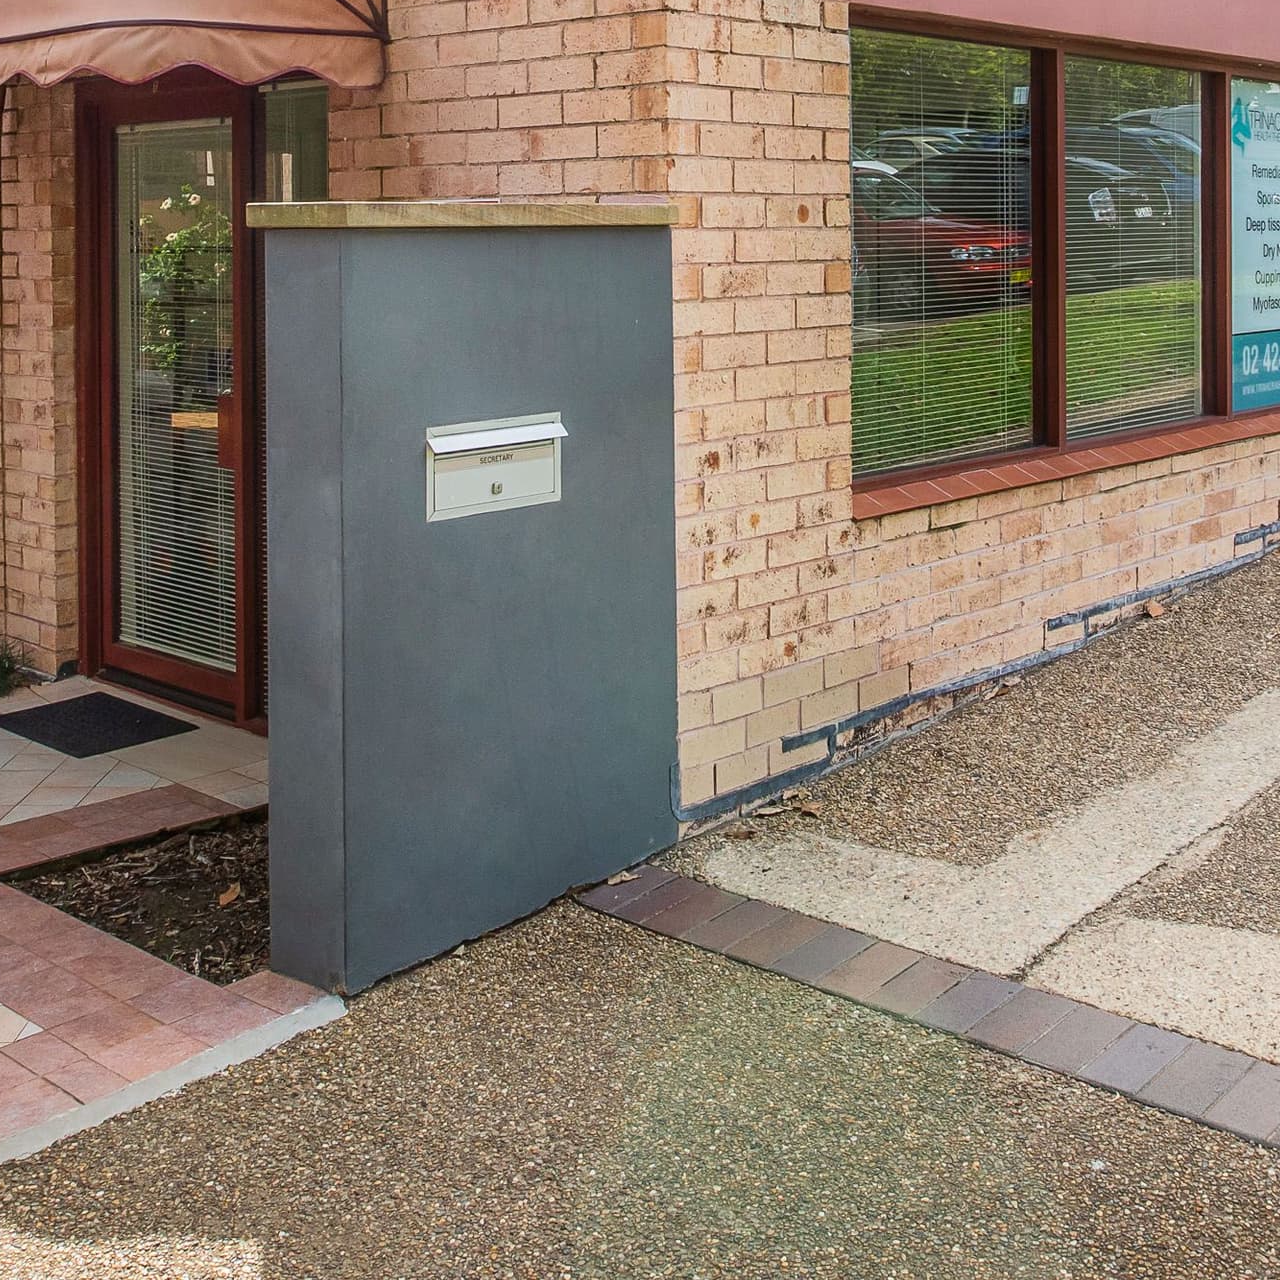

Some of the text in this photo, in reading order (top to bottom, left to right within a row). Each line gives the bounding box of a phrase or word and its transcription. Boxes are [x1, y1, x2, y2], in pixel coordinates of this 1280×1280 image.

[1257, 190, 1280, 207] Sports
[1246, 216, 1266, 234] Deep
[1263, 244, 1275, 260] Dry
[1242, 344, 1259, 376] 02
[479, 454, 514, 464] SECRETARY
